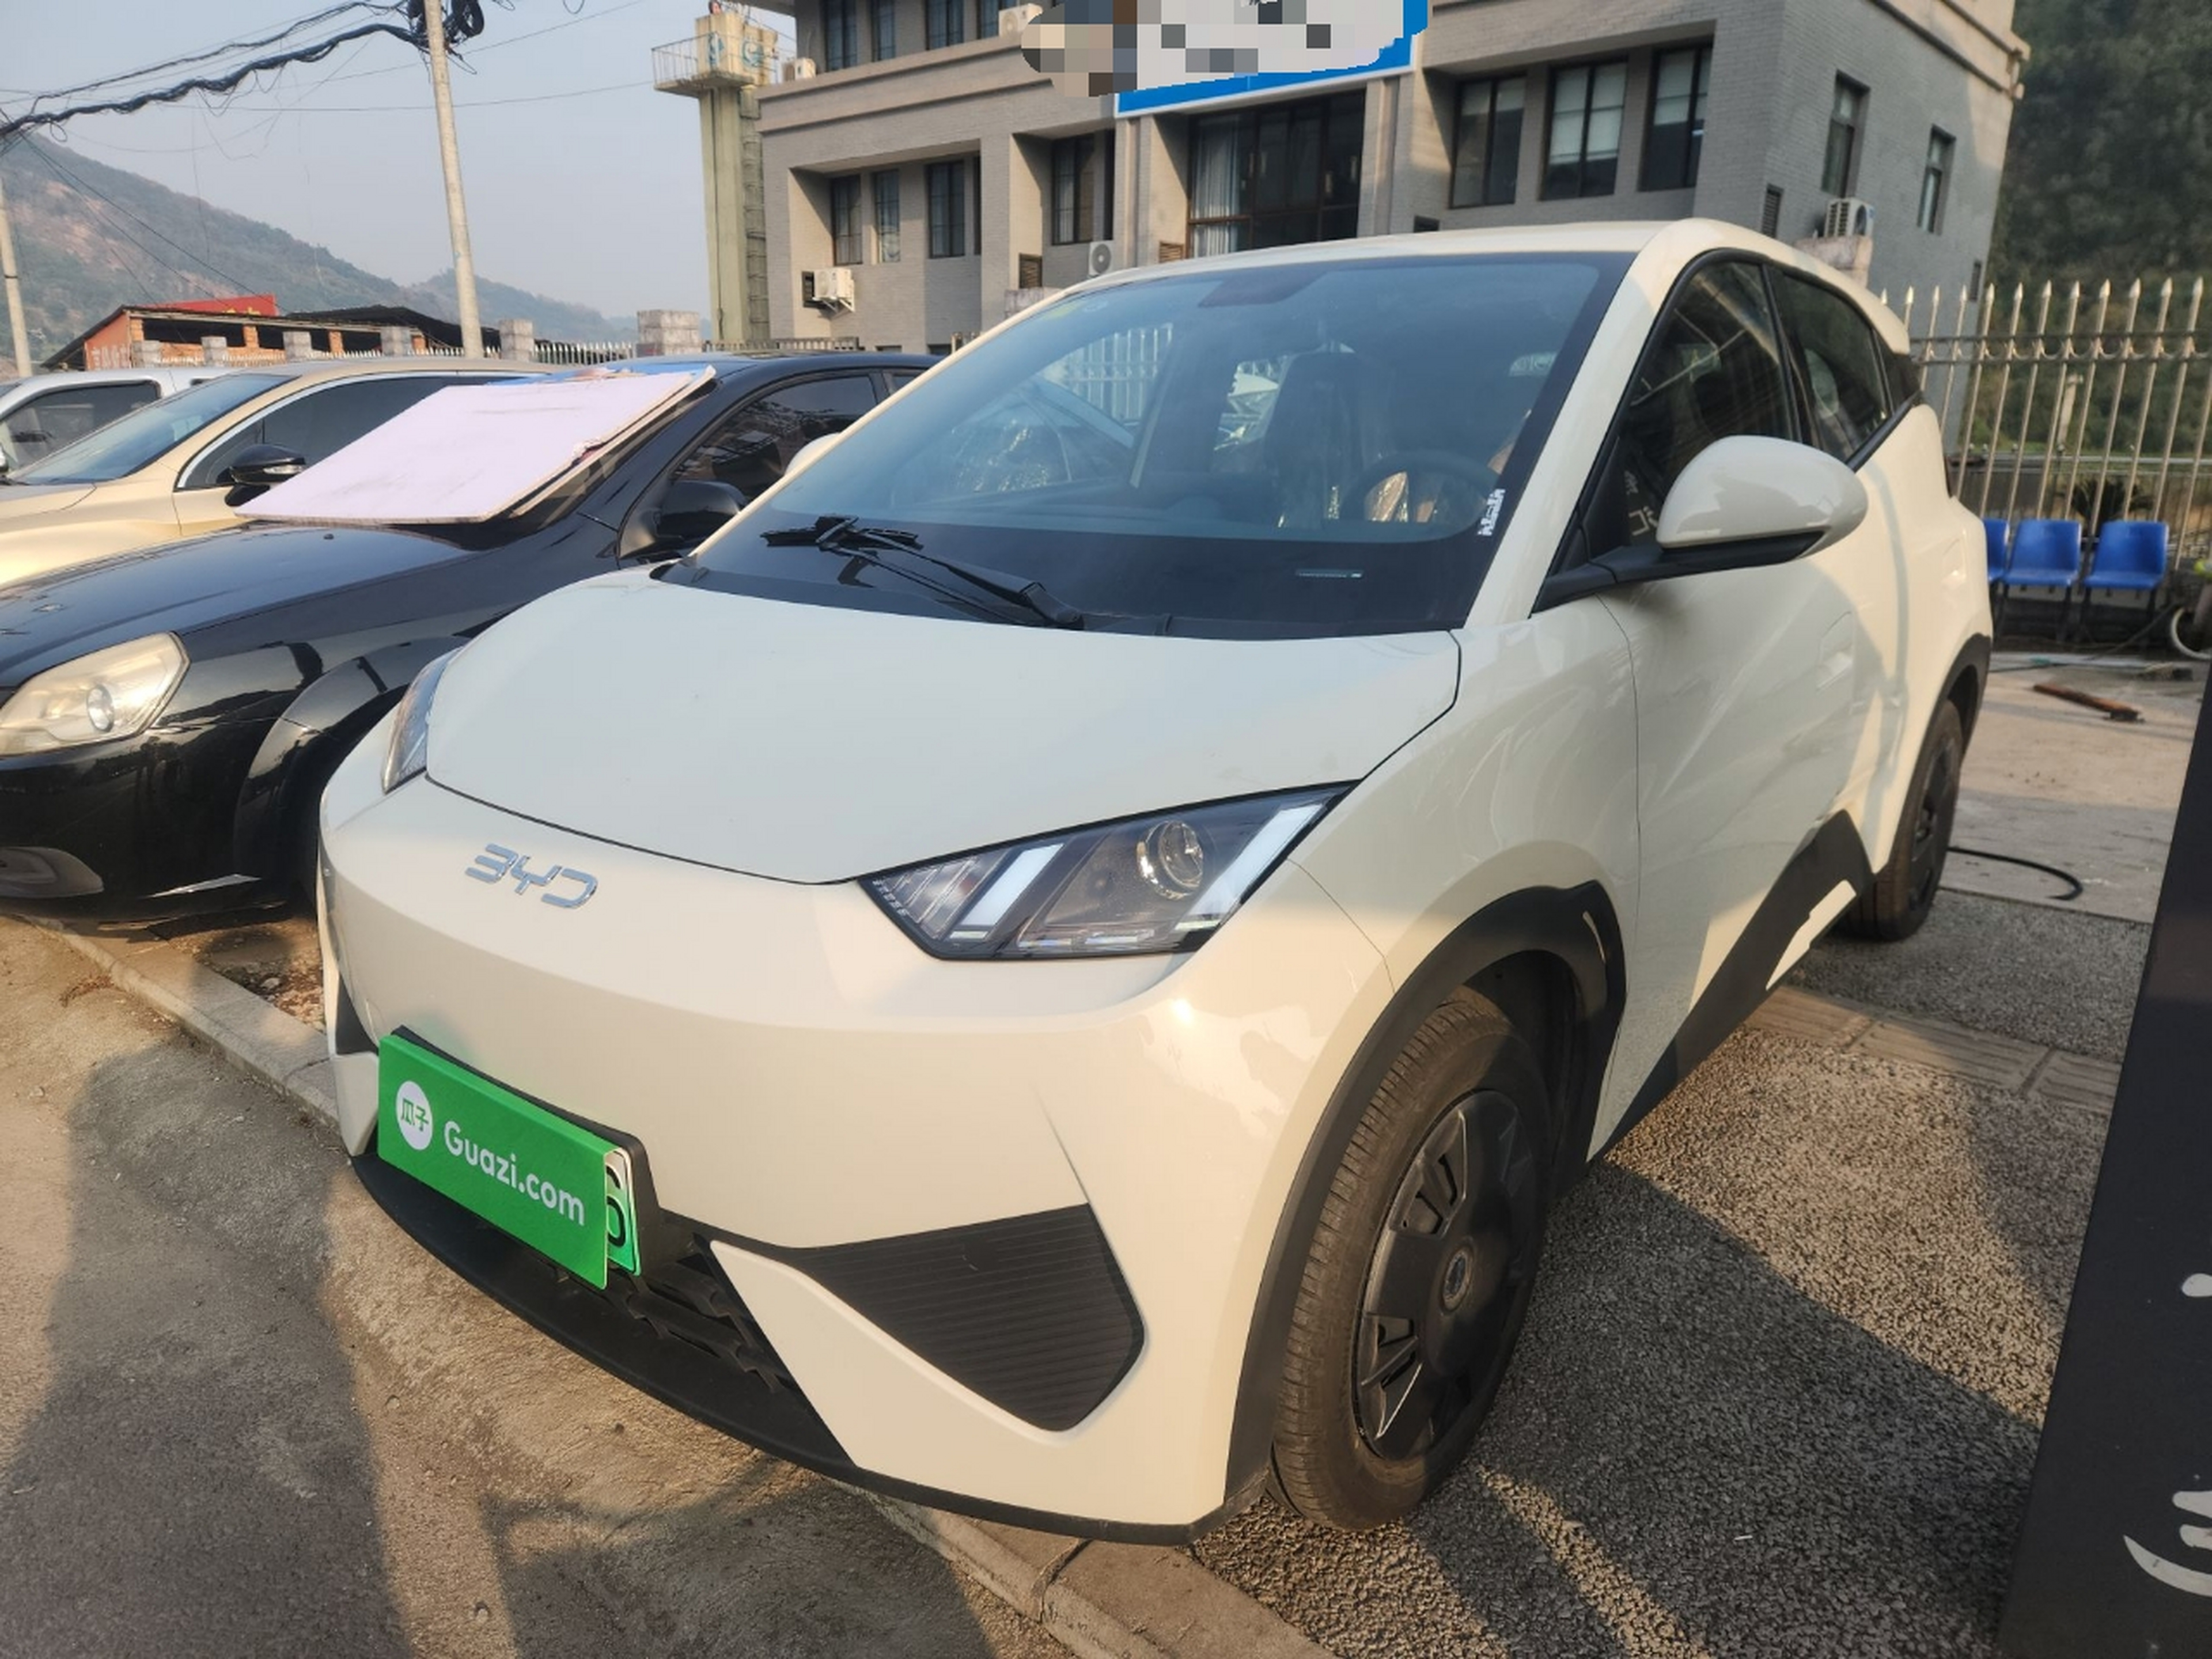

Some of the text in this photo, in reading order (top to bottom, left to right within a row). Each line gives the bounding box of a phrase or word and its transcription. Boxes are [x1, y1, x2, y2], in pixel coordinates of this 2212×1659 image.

[464, 843, 599, 909] BYD
[400, 1097, 429, 1132] 瓜子
[444, 1120, 585, 1226] Guazi.com
